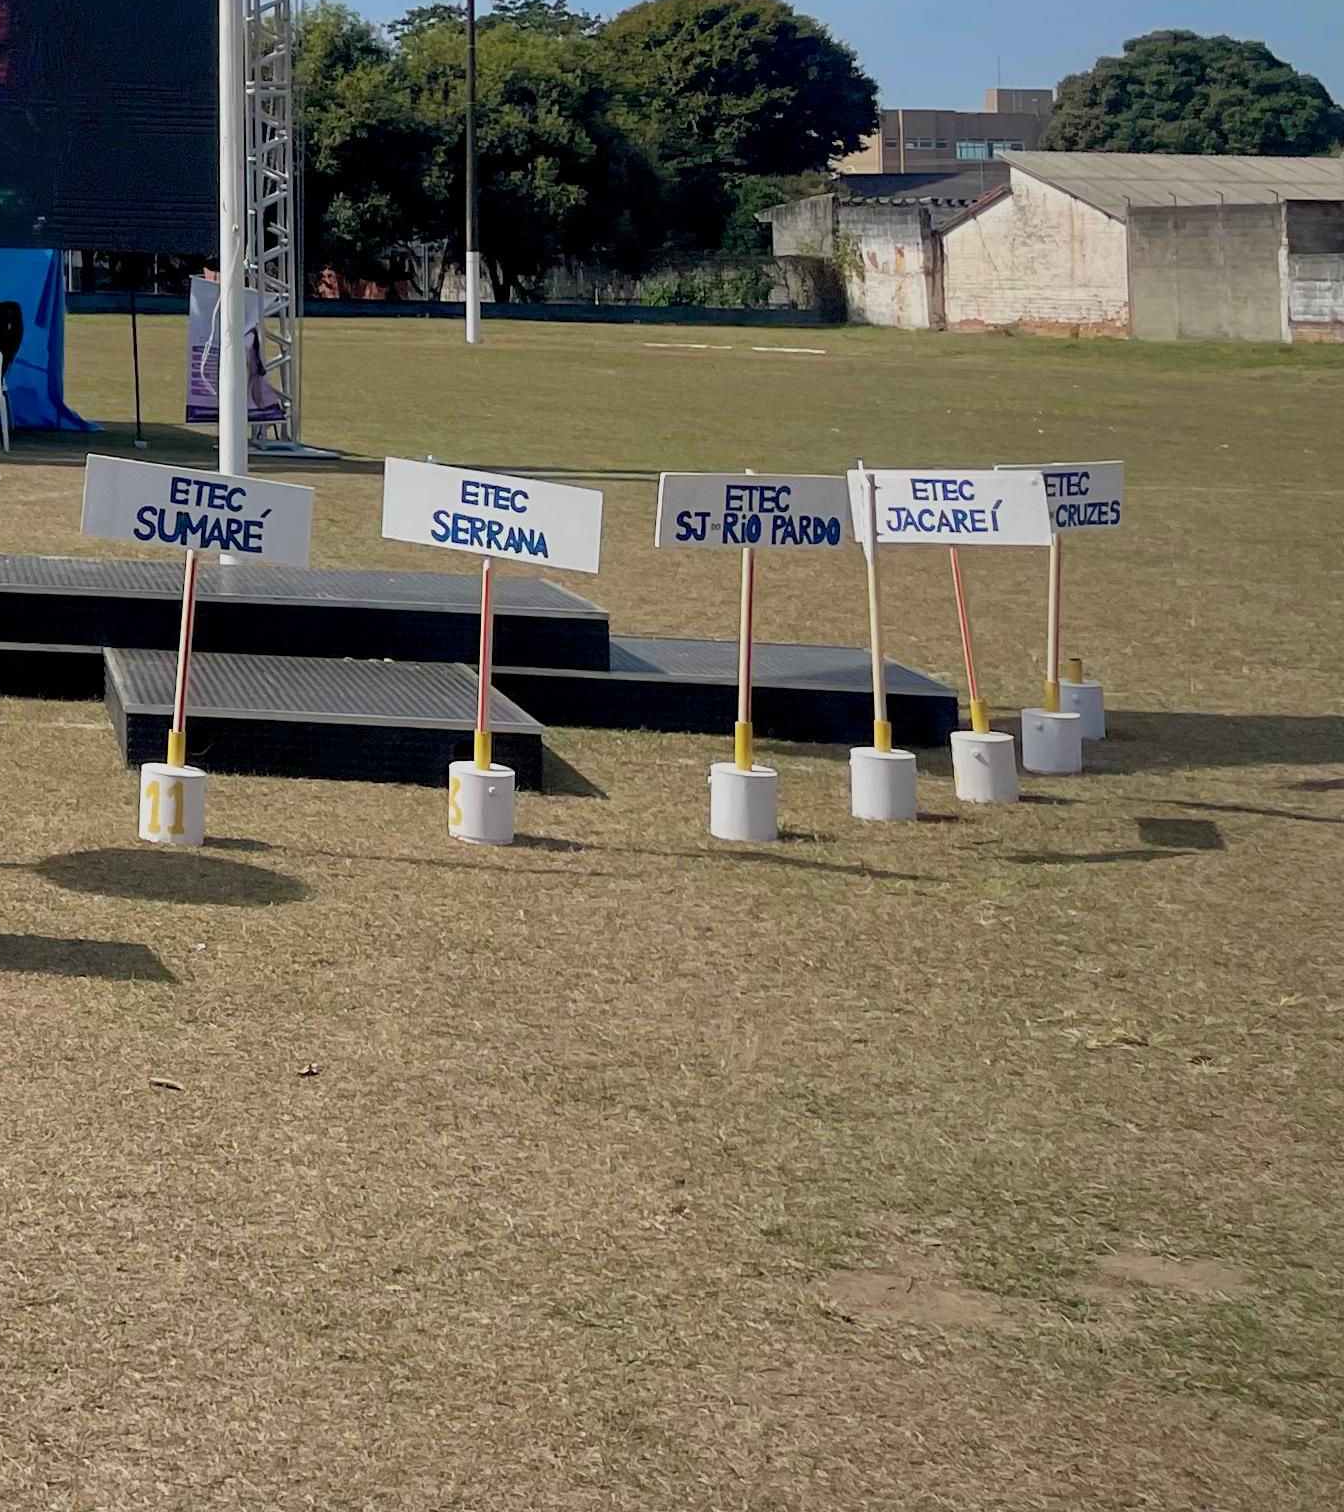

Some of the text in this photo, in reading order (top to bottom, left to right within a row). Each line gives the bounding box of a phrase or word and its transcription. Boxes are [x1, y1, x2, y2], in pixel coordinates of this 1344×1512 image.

[170, 476, 247, 513] ETEC
[461, 480, 529, 514] ETEC
[726, 484, 791, 513] ETEC
[911, 478, 976, 502] ETEC
[1044, 471, 1090, 497] ETEC
[133, 505, 272, 554] SUMARÉ
[771, 514, 841, 546] PARDO
[885, 499, 1004, 533] JACAREÍ
[1056, 500, 1120, 528] CRUZES
[431, 510, 549, 559] SERRANA
